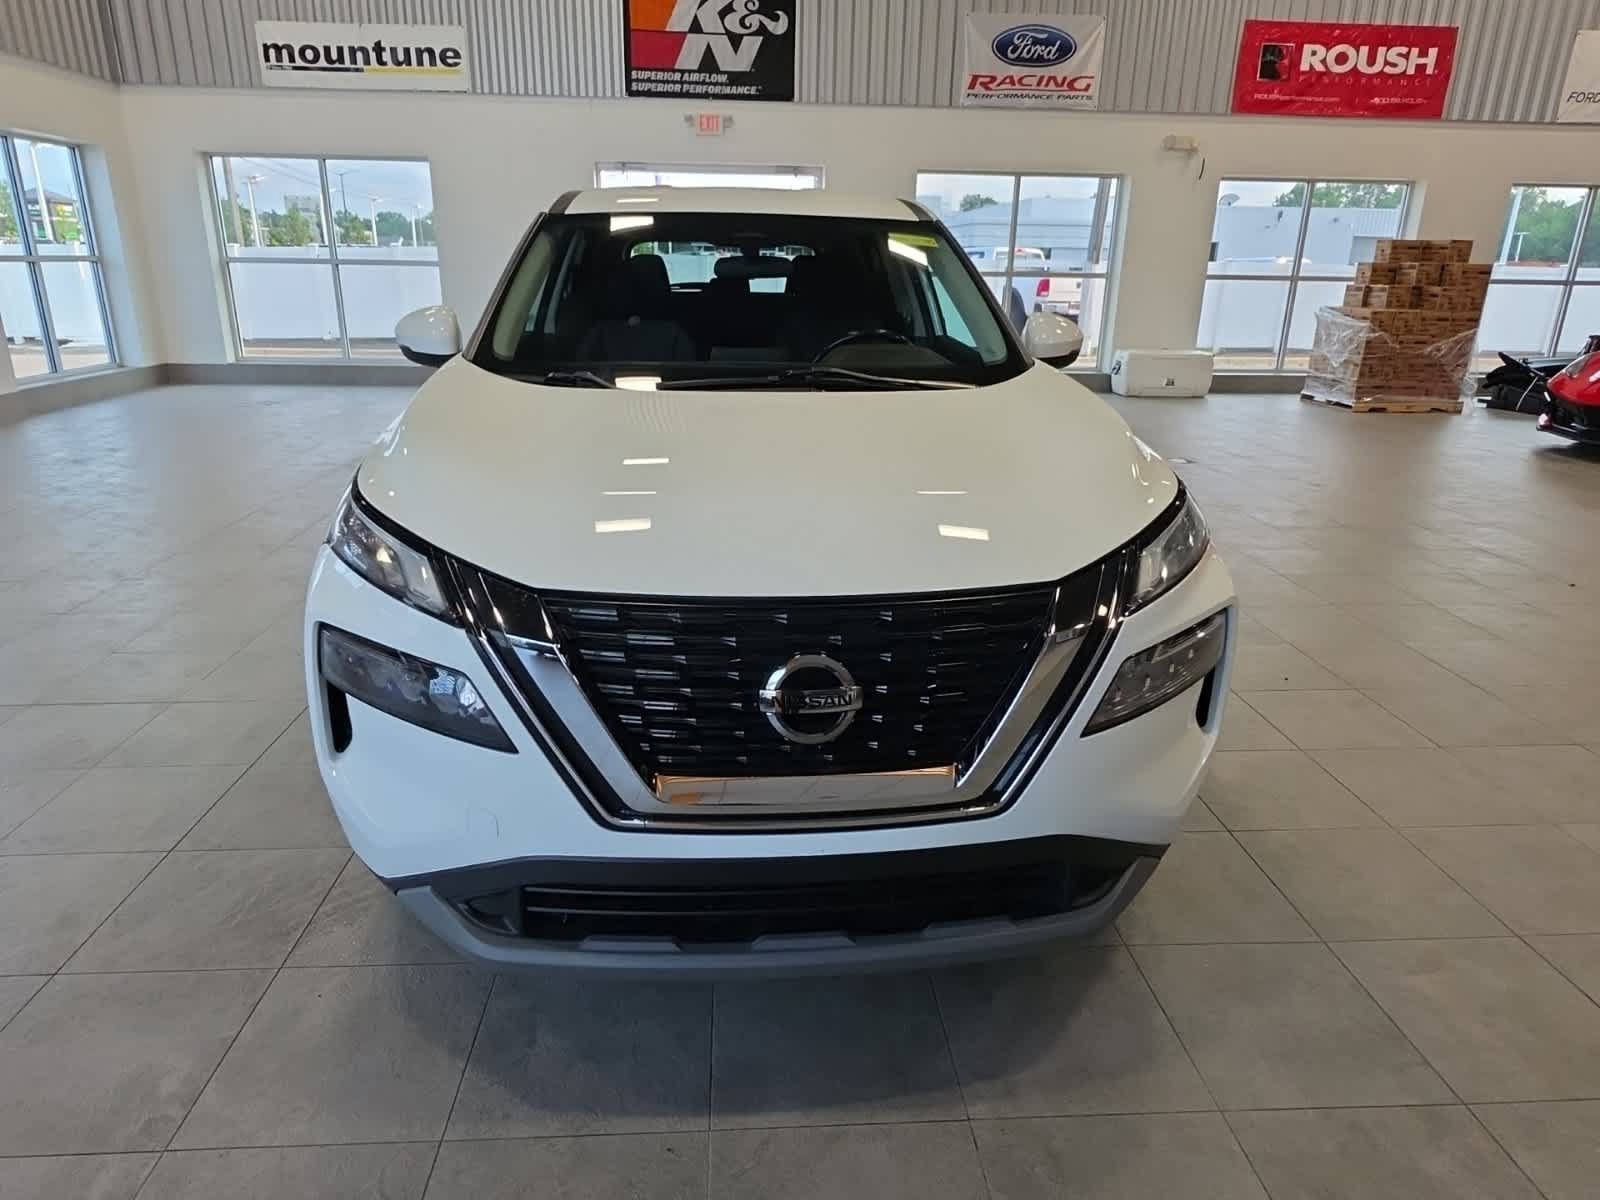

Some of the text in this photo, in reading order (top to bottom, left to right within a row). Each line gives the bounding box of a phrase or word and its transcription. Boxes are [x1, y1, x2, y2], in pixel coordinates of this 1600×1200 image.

[262, 39, 462, 68] mountune
[1007, 31, 1062, 60] Ford
[1300, 43, 1439, 75] ROUSH
[631, 70, 729, 83] SUPERIOR AIRFLOW.
[967, 74, 1095, 93] RACING
[631, 82, 681, 92] SUPERIOR
[966, 92, 1054, 101] PERFORMANCE
